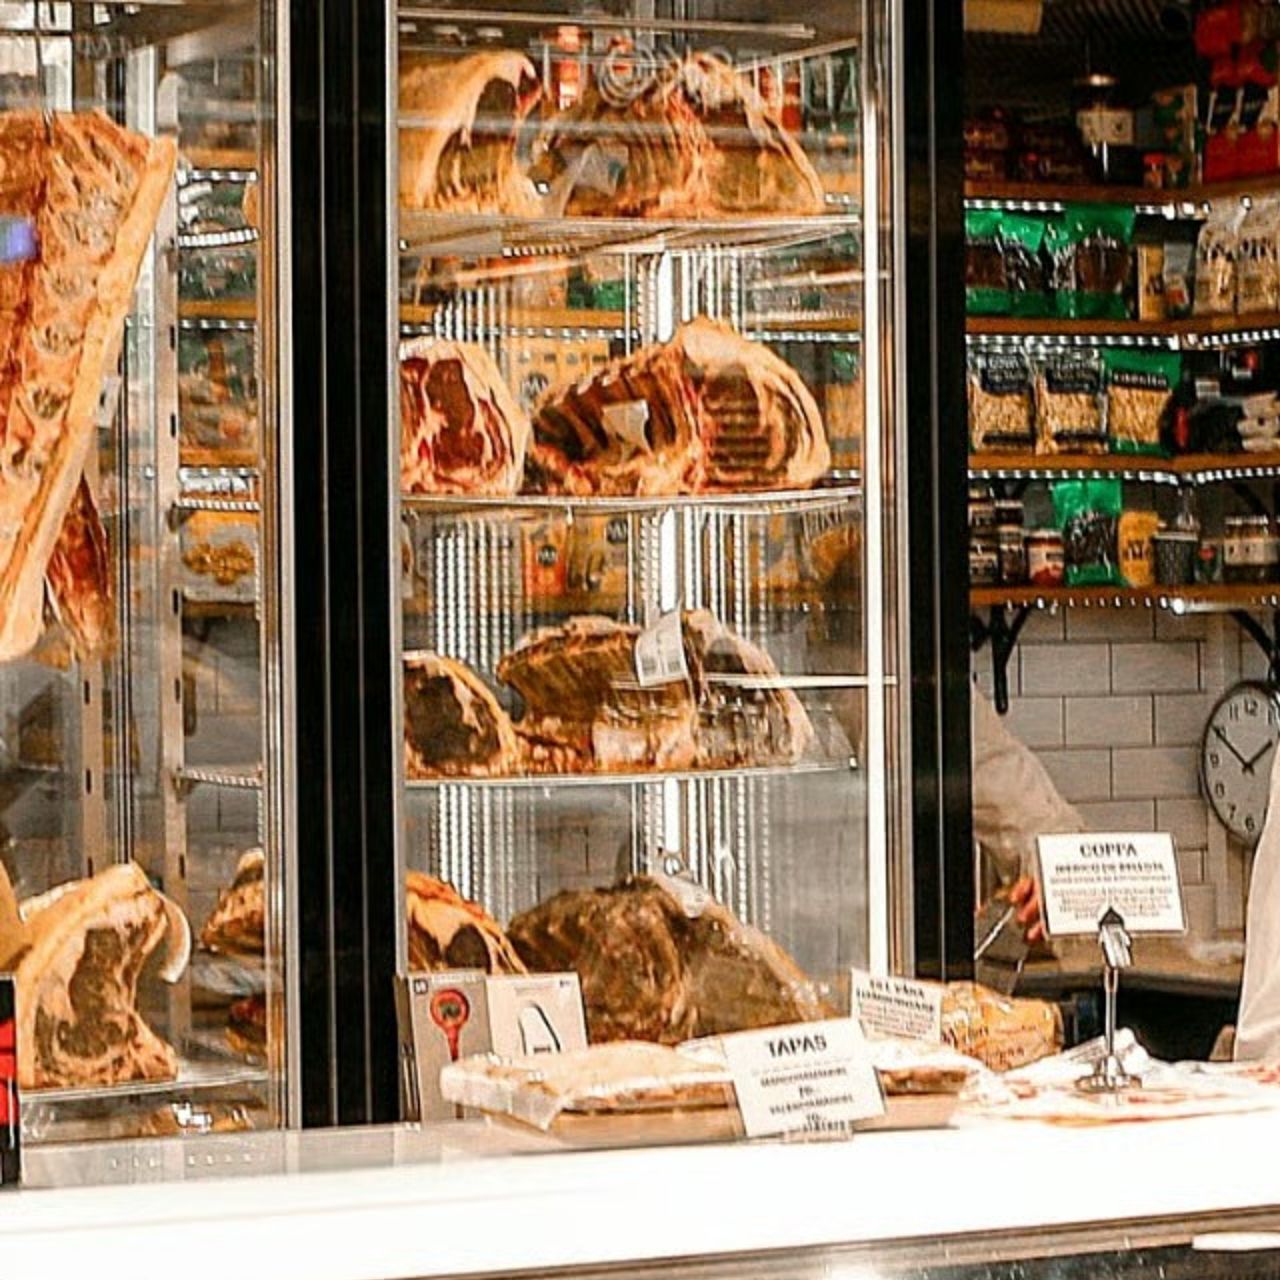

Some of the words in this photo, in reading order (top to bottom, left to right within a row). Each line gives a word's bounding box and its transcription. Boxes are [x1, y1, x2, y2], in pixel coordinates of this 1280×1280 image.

[1243, 698, 1258, 717] 12
[1228, 803, 1237, 820] 7
[1245, 816, 1255, 833] 6
[1079, 842, 1138, 858] COPPA
[767, 1033, 828, 1057] TAPAS
